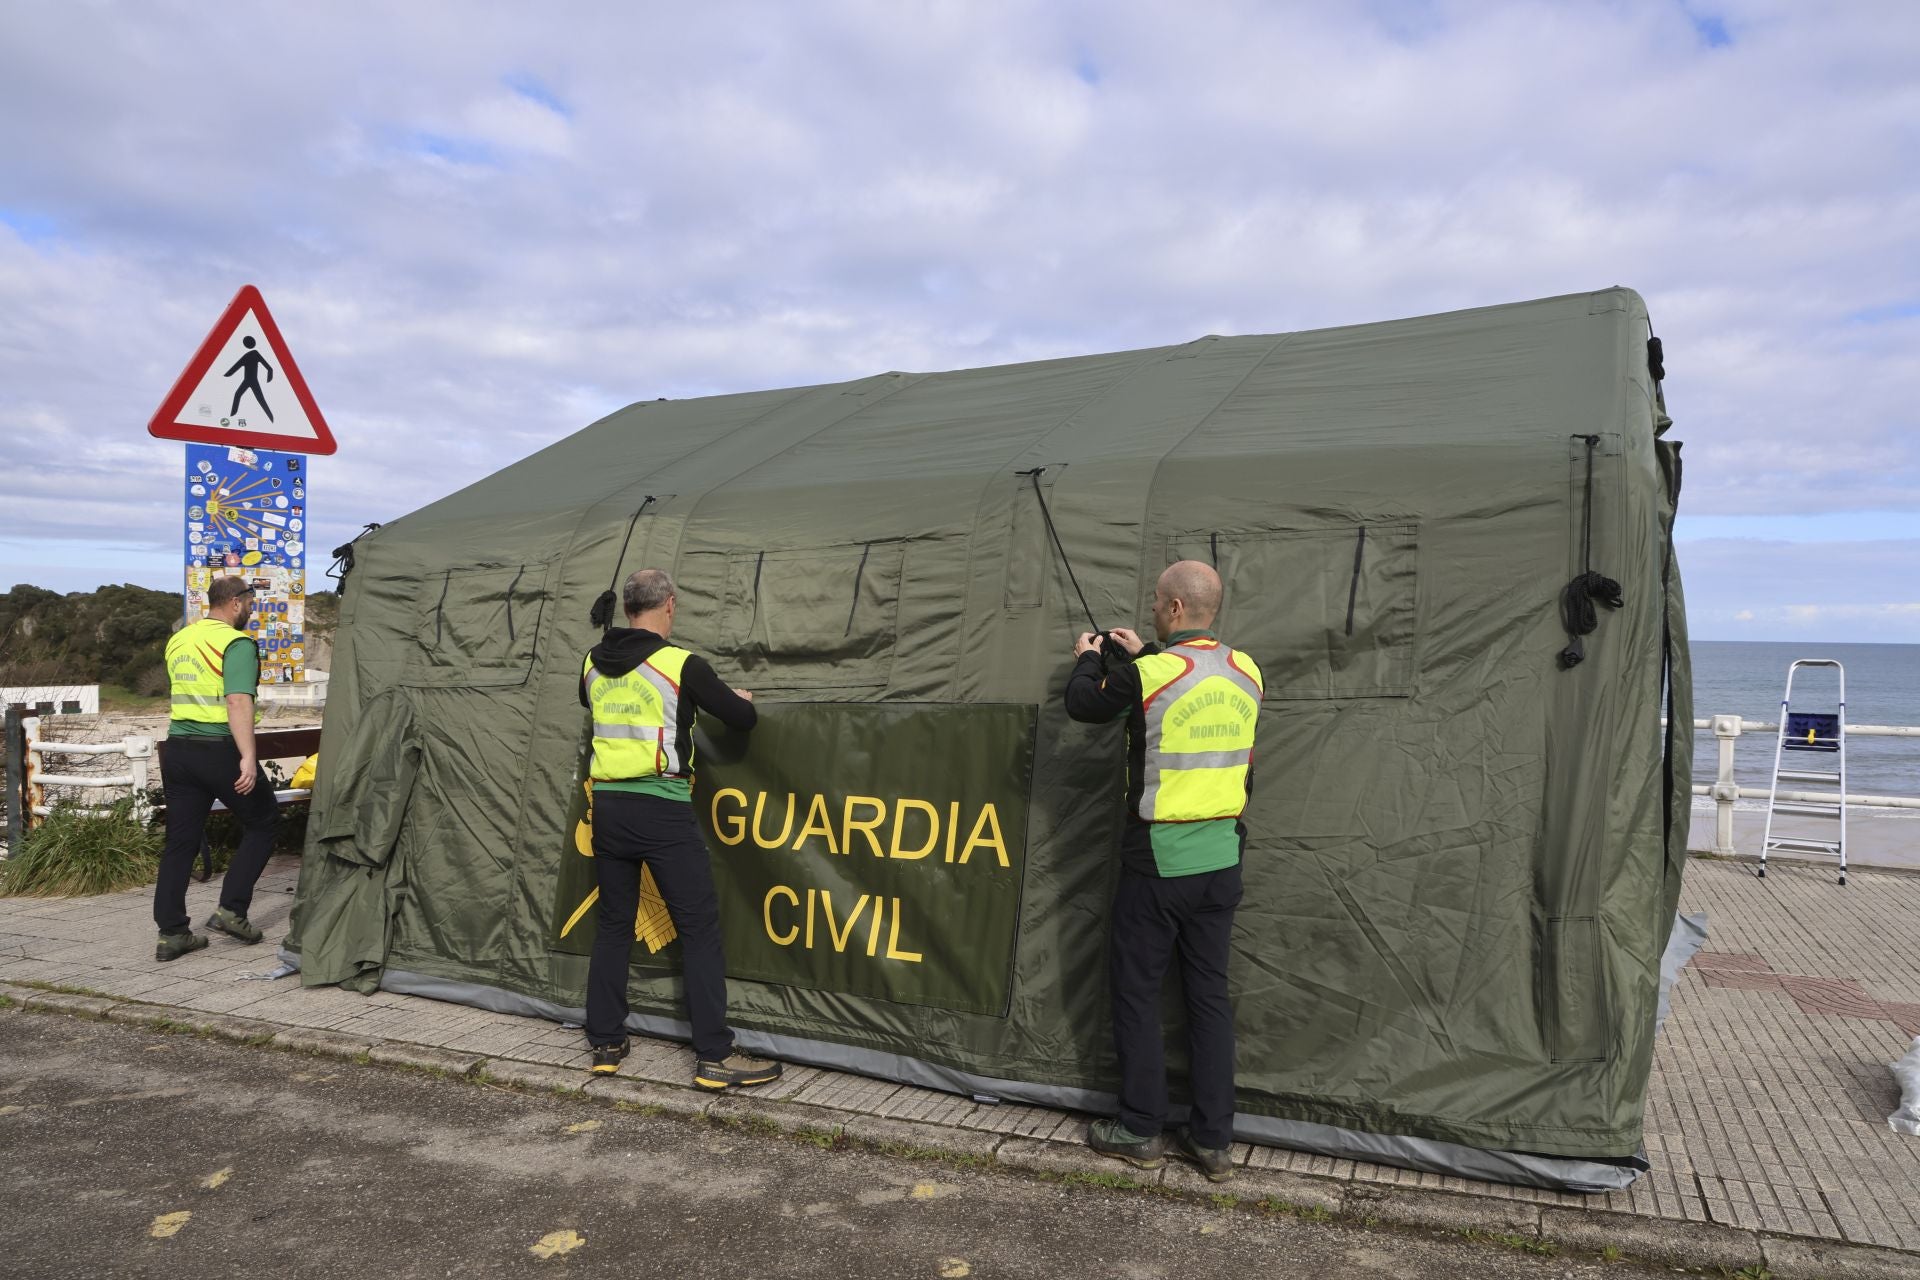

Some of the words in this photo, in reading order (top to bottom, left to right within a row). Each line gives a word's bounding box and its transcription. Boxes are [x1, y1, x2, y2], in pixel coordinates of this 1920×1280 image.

[252, 637, 291, 652] ago
[594, 677, 629, 703] GUARDIA
[632, 681, 655, 706] CIVIL
[1172, 691, 1225, 727] GUARDIA
[1229, 695, 1253, 724] CIVIL
[1189, 721, 1241, 740] MONTAÑA
[711, 787, 1010, 868] GUARDIA
[763, 885, 923, 963] CIVIL
